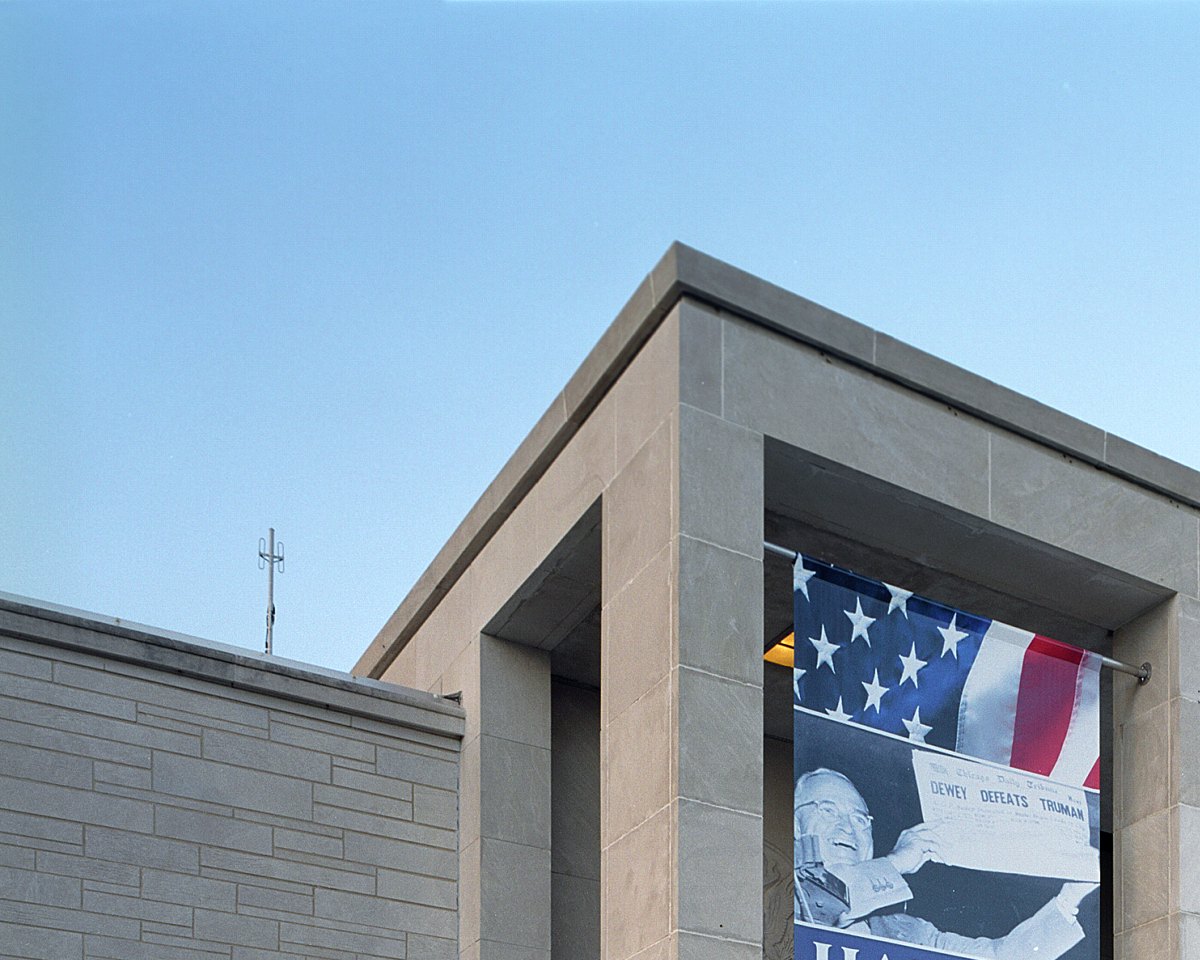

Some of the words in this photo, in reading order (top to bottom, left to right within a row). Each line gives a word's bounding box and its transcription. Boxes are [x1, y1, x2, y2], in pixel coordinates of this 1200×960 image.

[929, 780, 967, 800] DEWEY
[980, 789, 1029, 809] DEFEATS
[1039, 797, 1085, 821] TRUMAN
